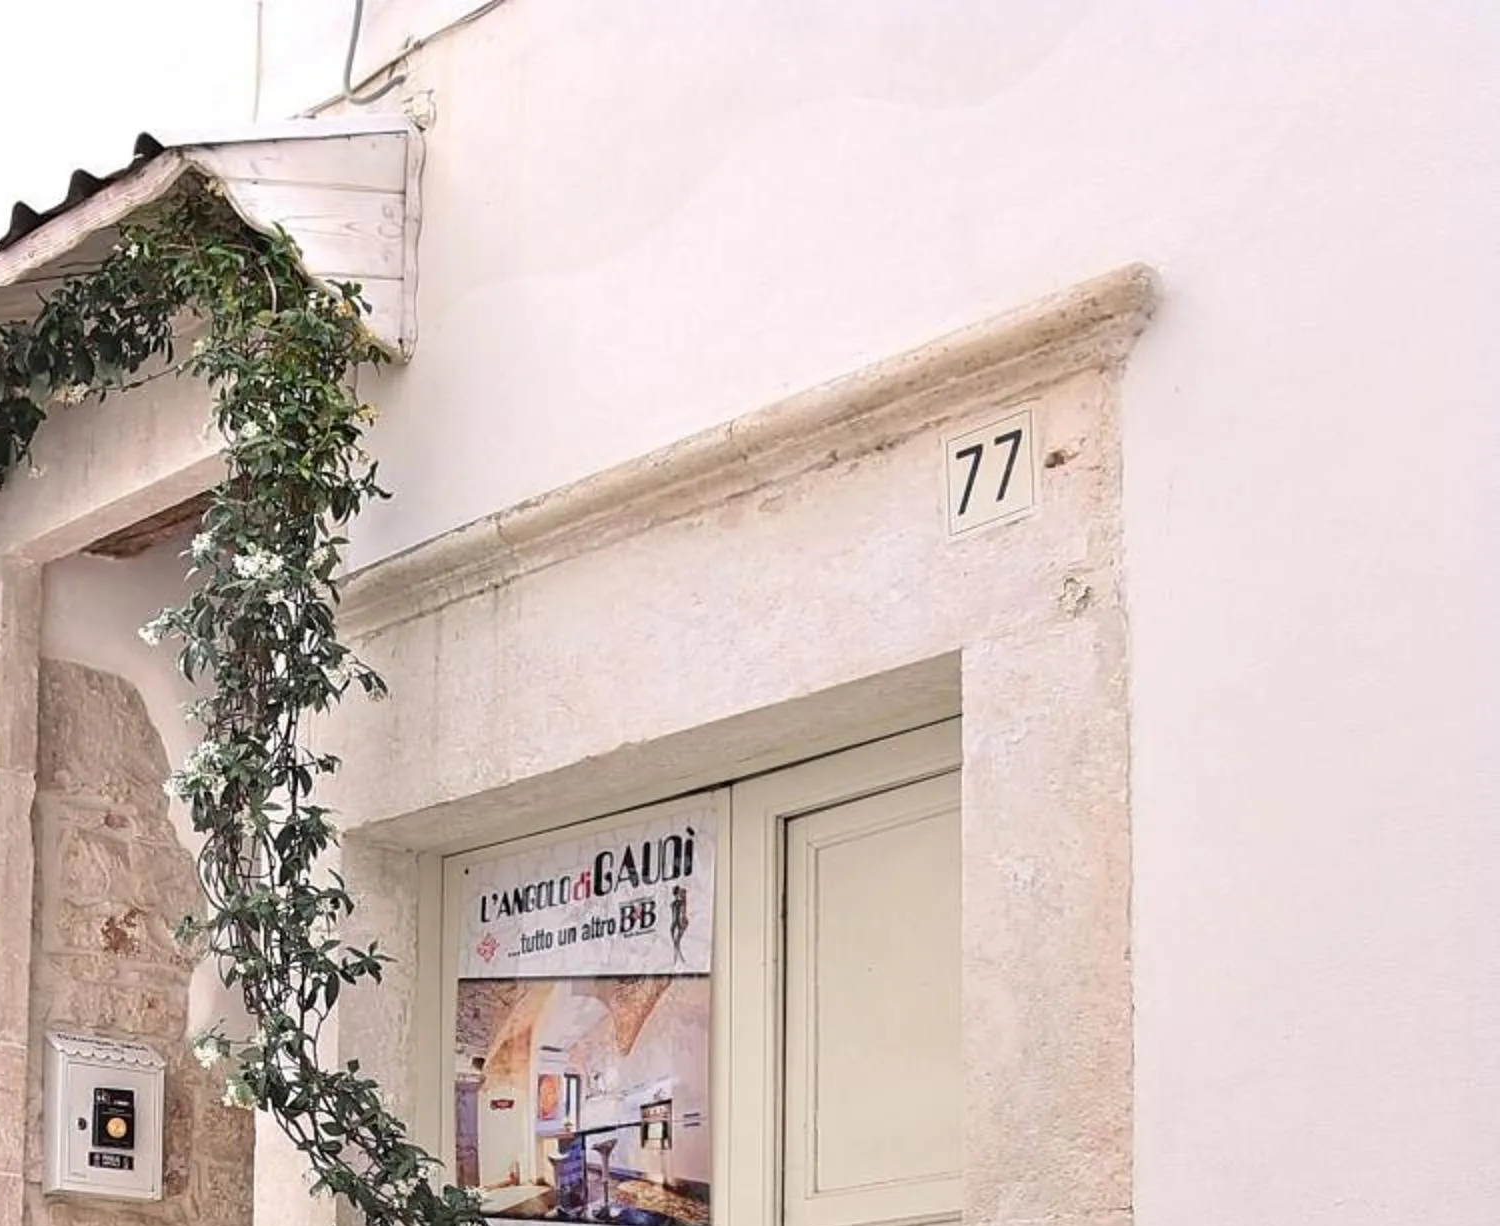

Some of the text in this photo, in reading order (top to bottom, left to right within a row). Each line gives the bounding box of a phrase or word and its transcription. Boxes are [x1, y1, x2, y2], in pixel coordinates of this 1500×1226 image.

[956, 429, 1022, 516] 77
[558, 926, 577, 946] un
[581, 916, 616, 941] altro
